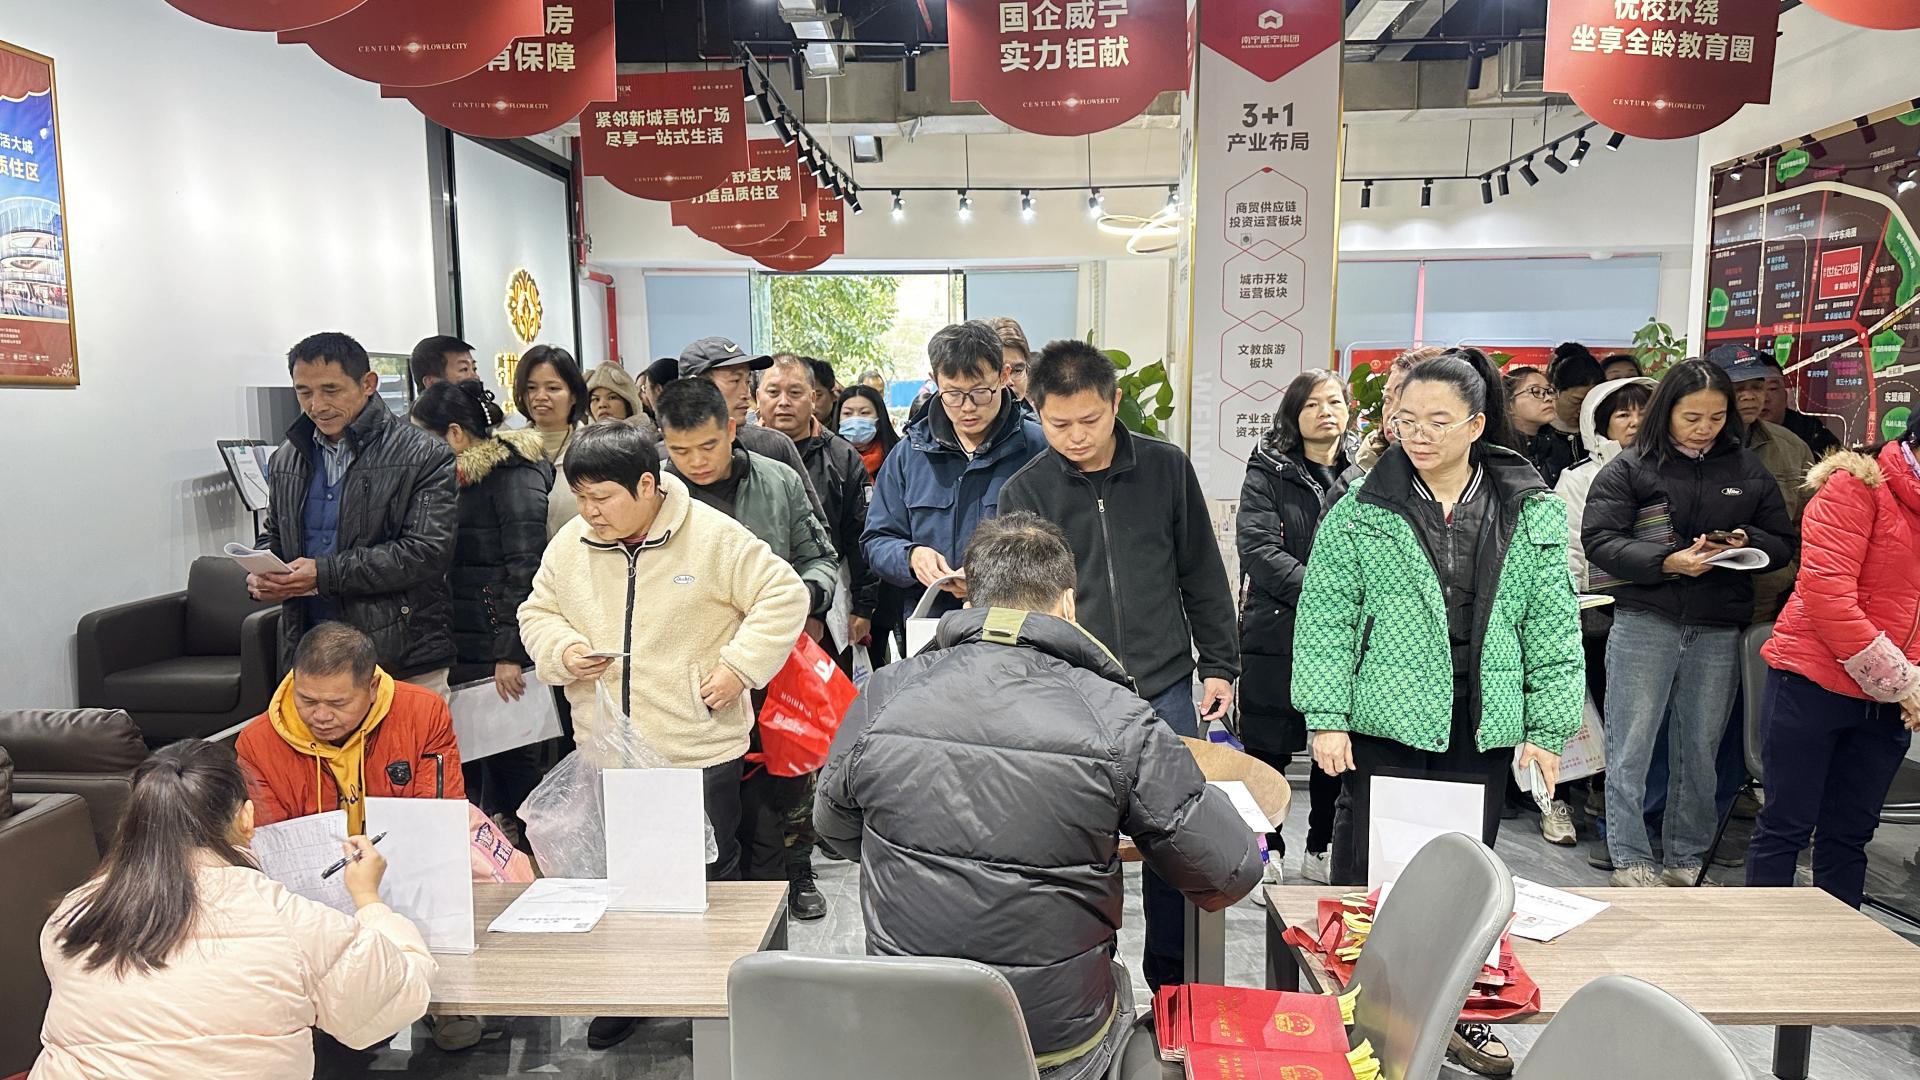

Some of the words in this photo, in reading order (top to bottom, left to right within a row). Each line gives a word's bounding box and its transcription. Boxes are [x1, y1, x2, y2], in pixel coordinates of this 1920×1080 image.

[1000, 0, 1128, 33] 国企威宁
[1615, 0, 1719, 26] 优校环绕
[1571, 24, 1755, 63] 坐享全龄教育圈
[1000, 36, 1130, 72] 实力钜献
[1613, 98, 1651, 106] CENTURY
[595, 107, 730, 128] 紧邻新城吾悦广场
[1242, 102, 1294, 128] 3+1
[606, 127, 724, 148] 尽享一站式生活
[1227, 132, 1310, 152] 产业布局
[725, 166, 792, 184] 舒适大城
[1236, 202, 1297, 214] 商贸供应链
[1229, 215, 1302, 228] 投资运营板块
[1240, 273, 1289, 285] 城市开发
[1239, 286, 1288, 299] 运营板块
[1238, 343, 1286, 356] 文教旅游
[1250, 357, 1273, 369] 板块
